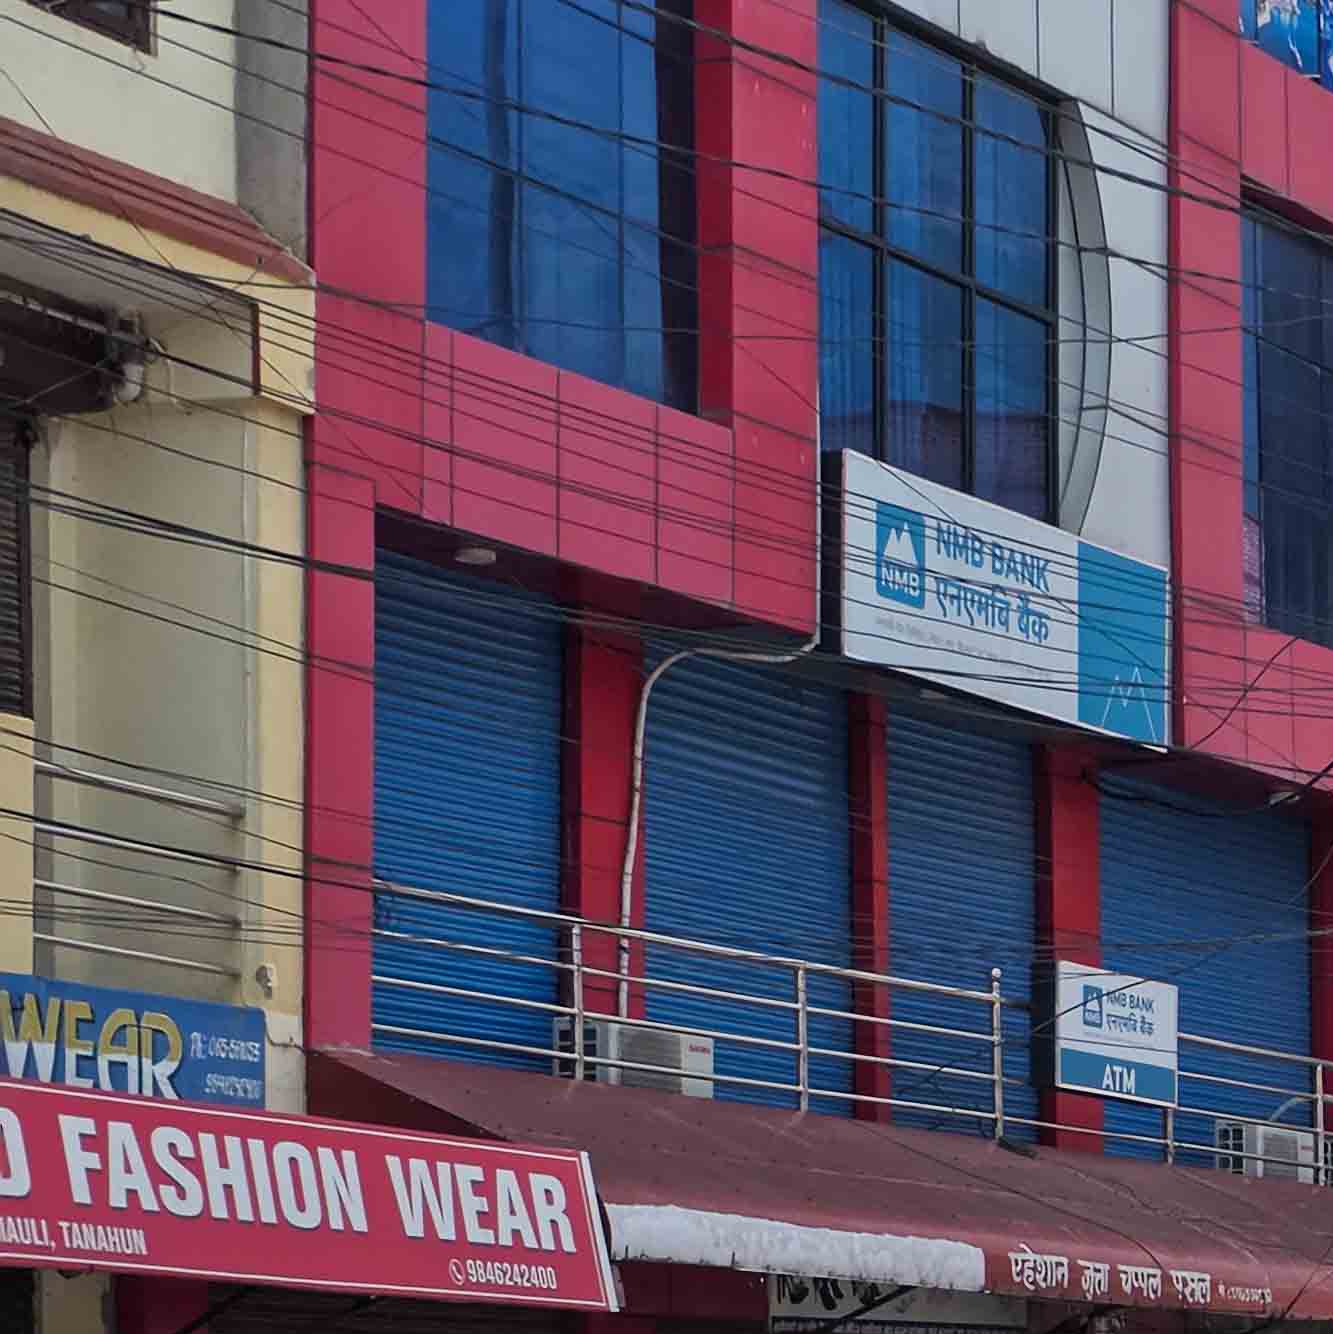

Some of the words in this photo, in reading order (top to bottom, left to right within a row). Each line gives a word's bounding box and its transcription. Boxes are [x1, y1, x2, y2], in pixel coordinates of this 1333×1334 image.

[936, 519, 985, 569] NMB
[991, 541, 1050, 594] BANK
[880, 565, 921, 598] NMB
[1128, 993, 1155, 1014] BANK
[0, 989, 184, 1100] WEAR
[1102, 1063, 1136, 1095] ATM
[57, 1113, 368, 1233] FASHION
[384, 1154, 576, 1253] WEAR
[58, 1220, 148, 1255] TANAHUN
[466, 1258, 557, 1290] 9846242400
